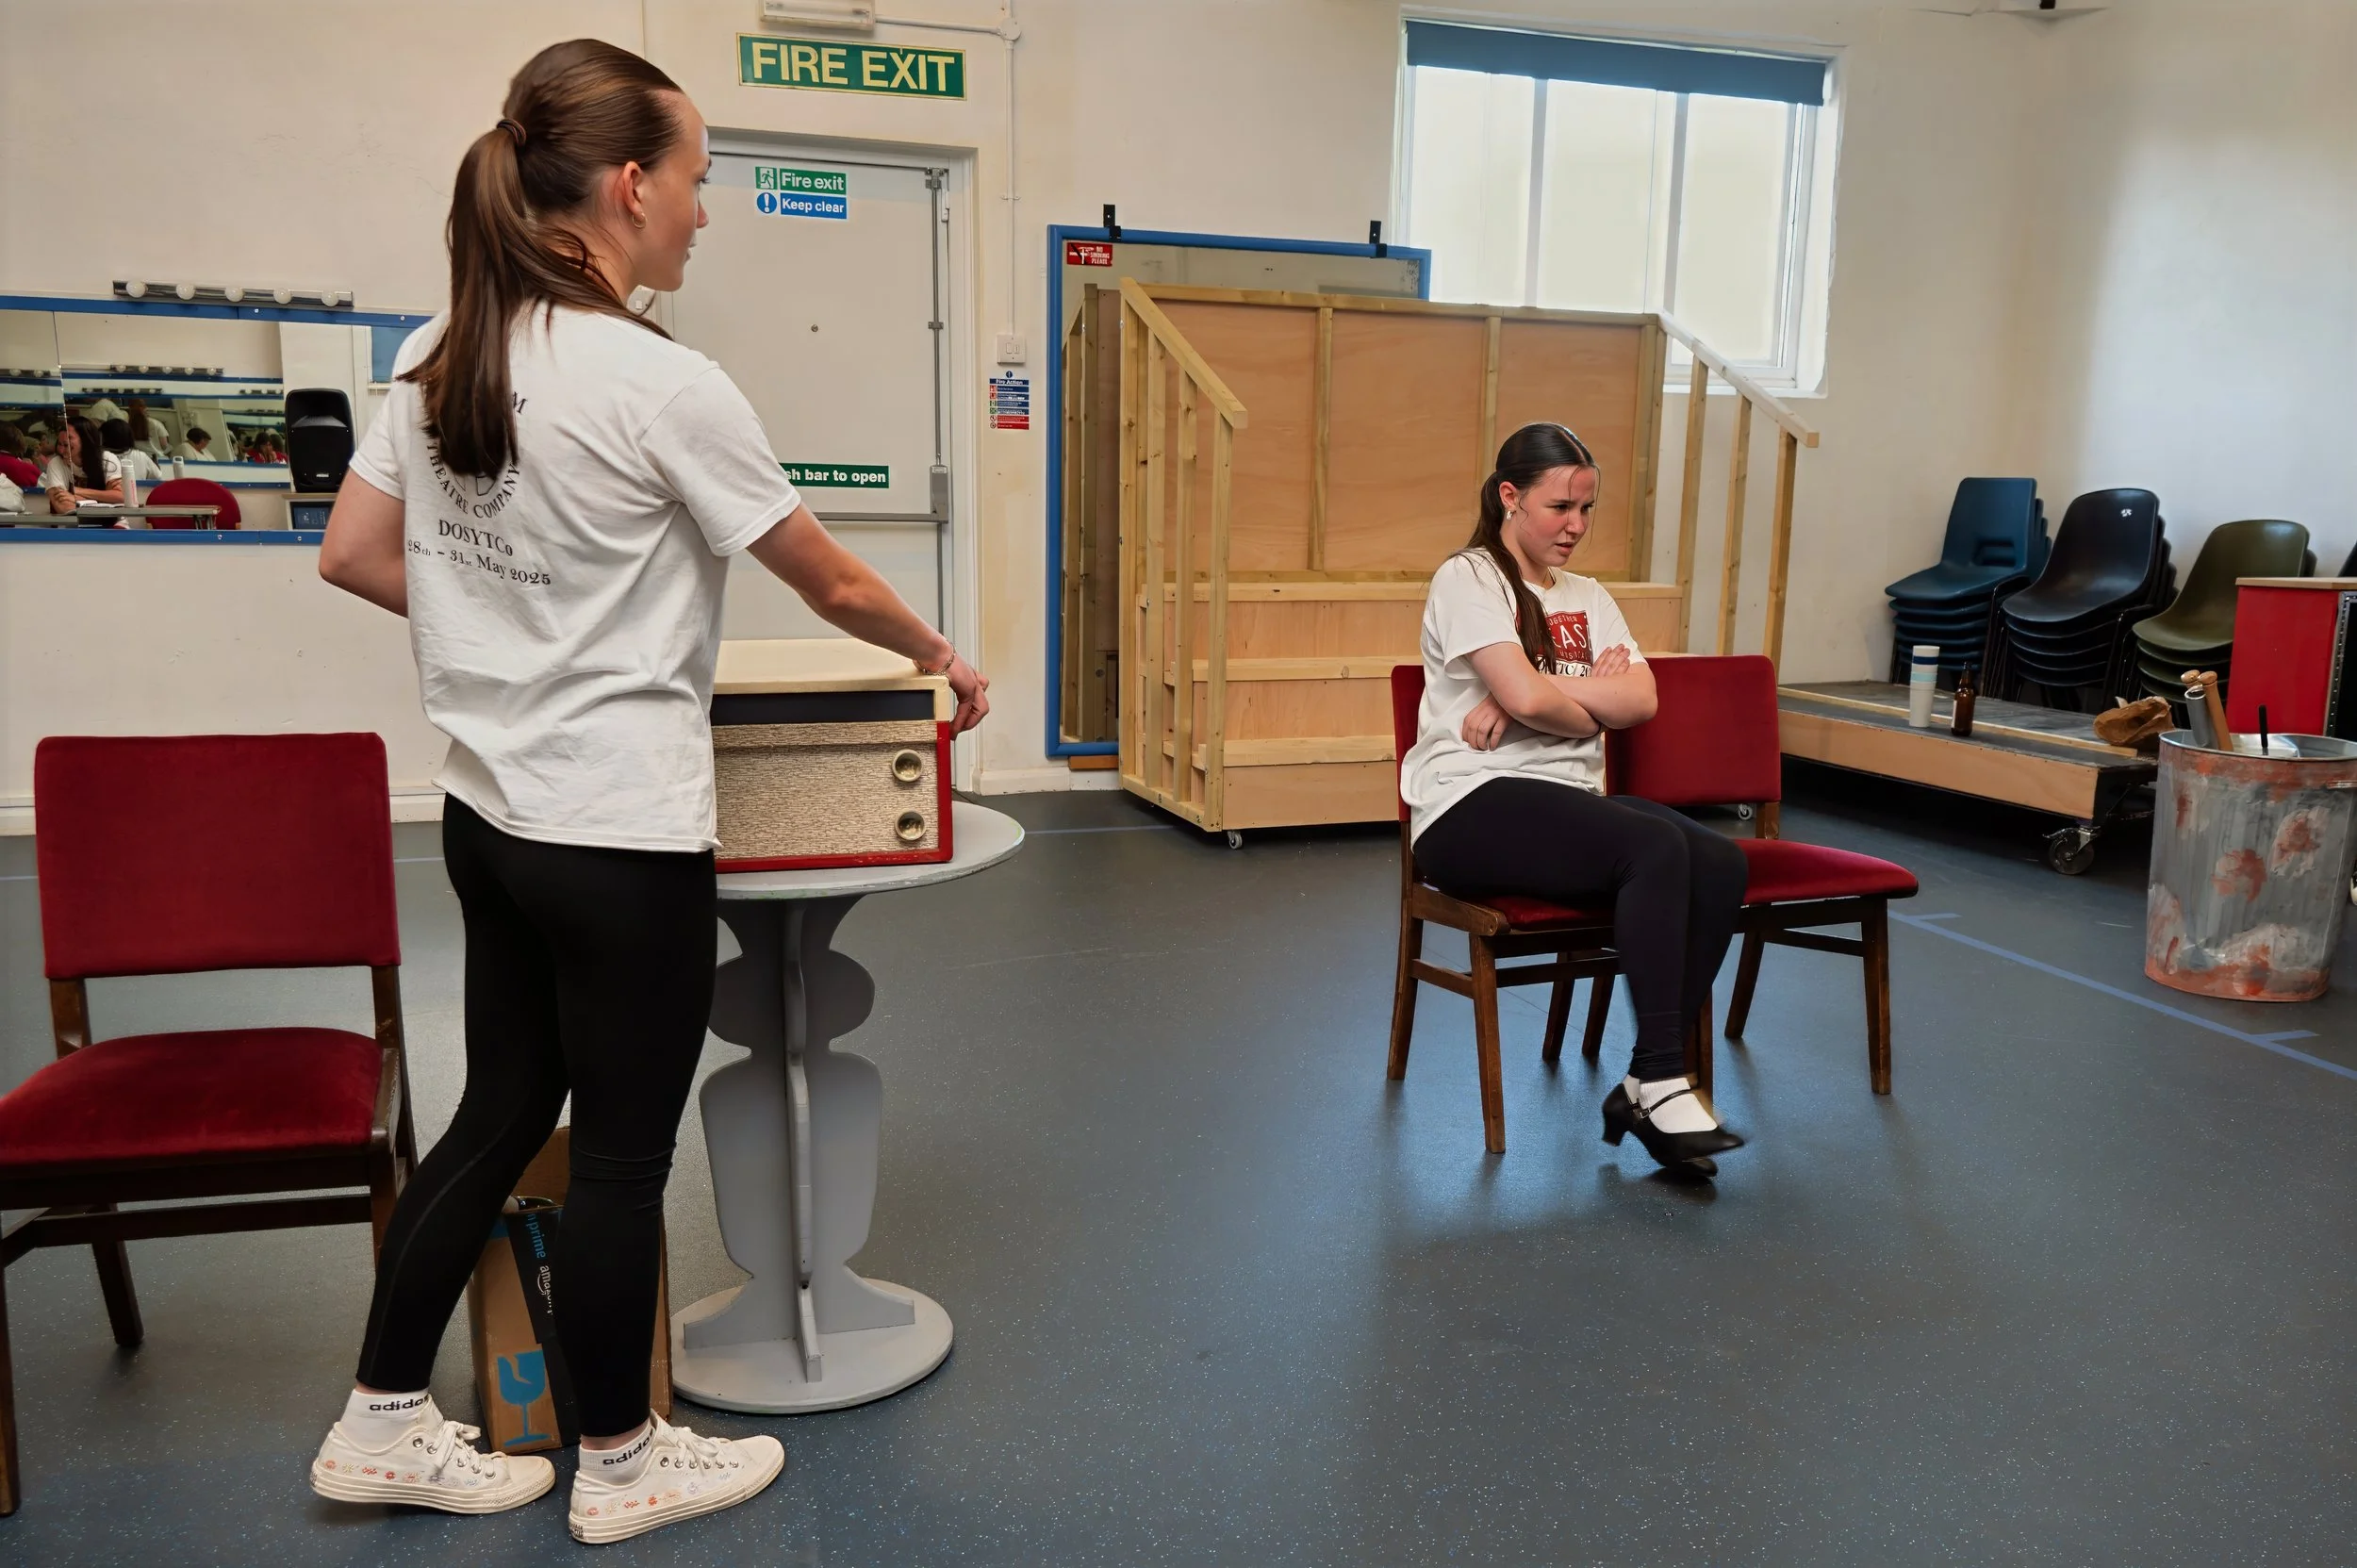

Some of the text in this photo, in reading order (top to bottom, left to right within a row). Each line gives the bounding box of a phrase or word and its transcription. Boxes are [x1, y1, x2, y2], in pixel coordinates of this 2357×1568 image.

[752, 42, 955, 91] FIRE EXIT
[782, 172, 844, 190] Fire exit
[782, 198, 844, 213] Keep clear
[427, 441, 520, 519] THEATRE COMPANY
[786, 469, 886, 485] sh bar to open
[476, 553, 507, 580] May
[510, 568, 552, 586] 2025
[526, 1221, 547, 1259] prime
[369, 1394, 429, 1411] adida
[602, 1428, 653, 1465] adida
